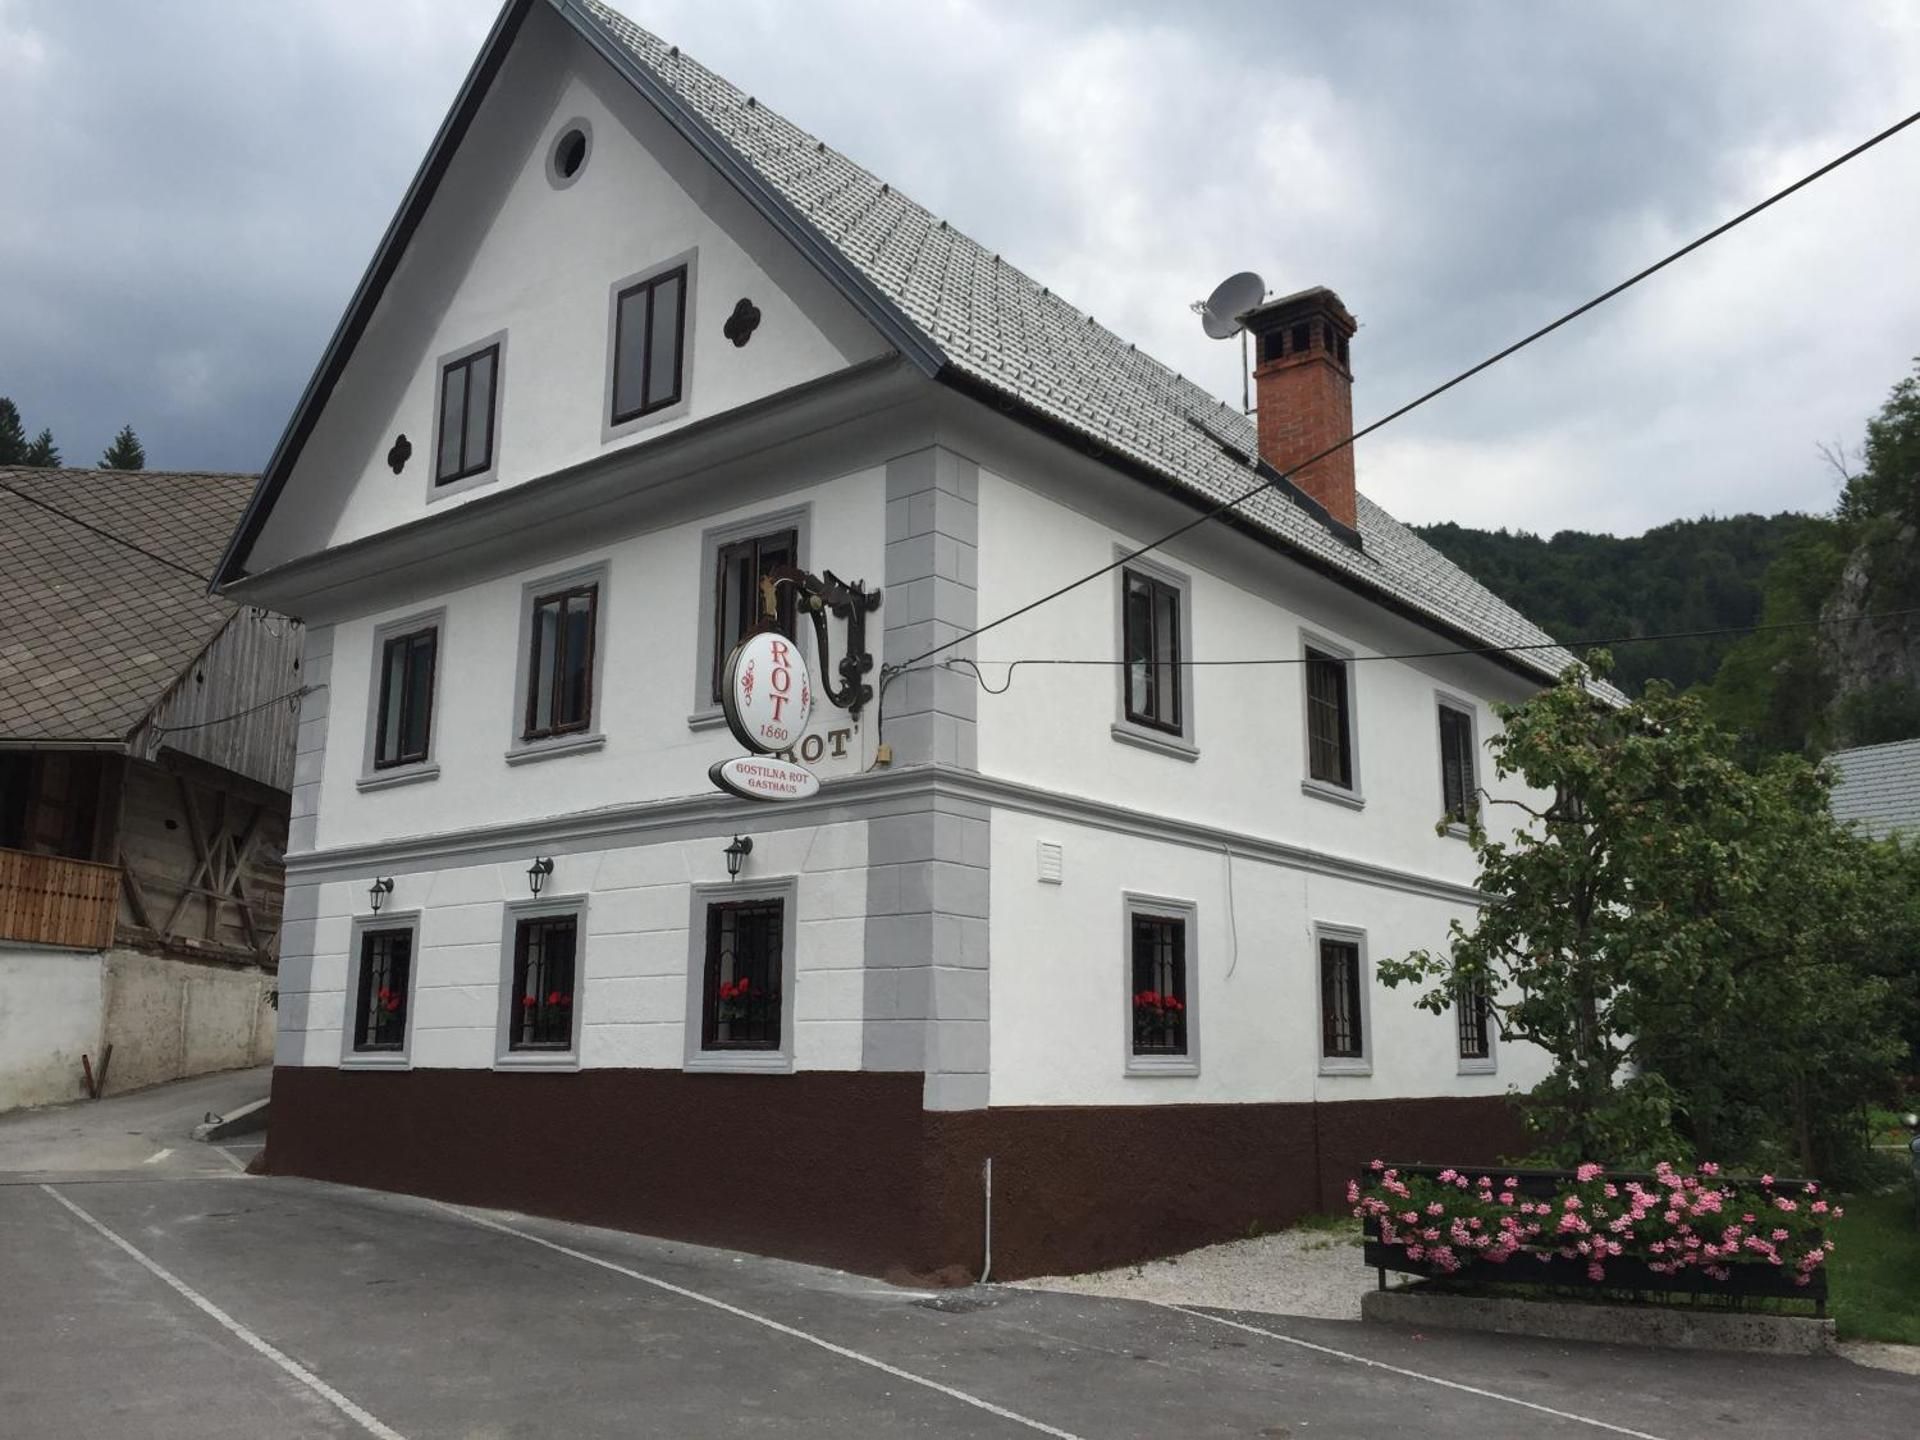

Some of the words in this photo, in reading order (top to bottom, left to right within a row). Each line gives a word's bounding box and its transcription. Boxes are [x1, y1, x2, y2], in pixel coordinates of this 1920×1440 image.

[769, 640, 791, 721] ROT
[735, 763, 787, 781] GOSTILNA
[789, 773, 809, 784] ROT
[748, 778, 797, 793] GASTHAUS
